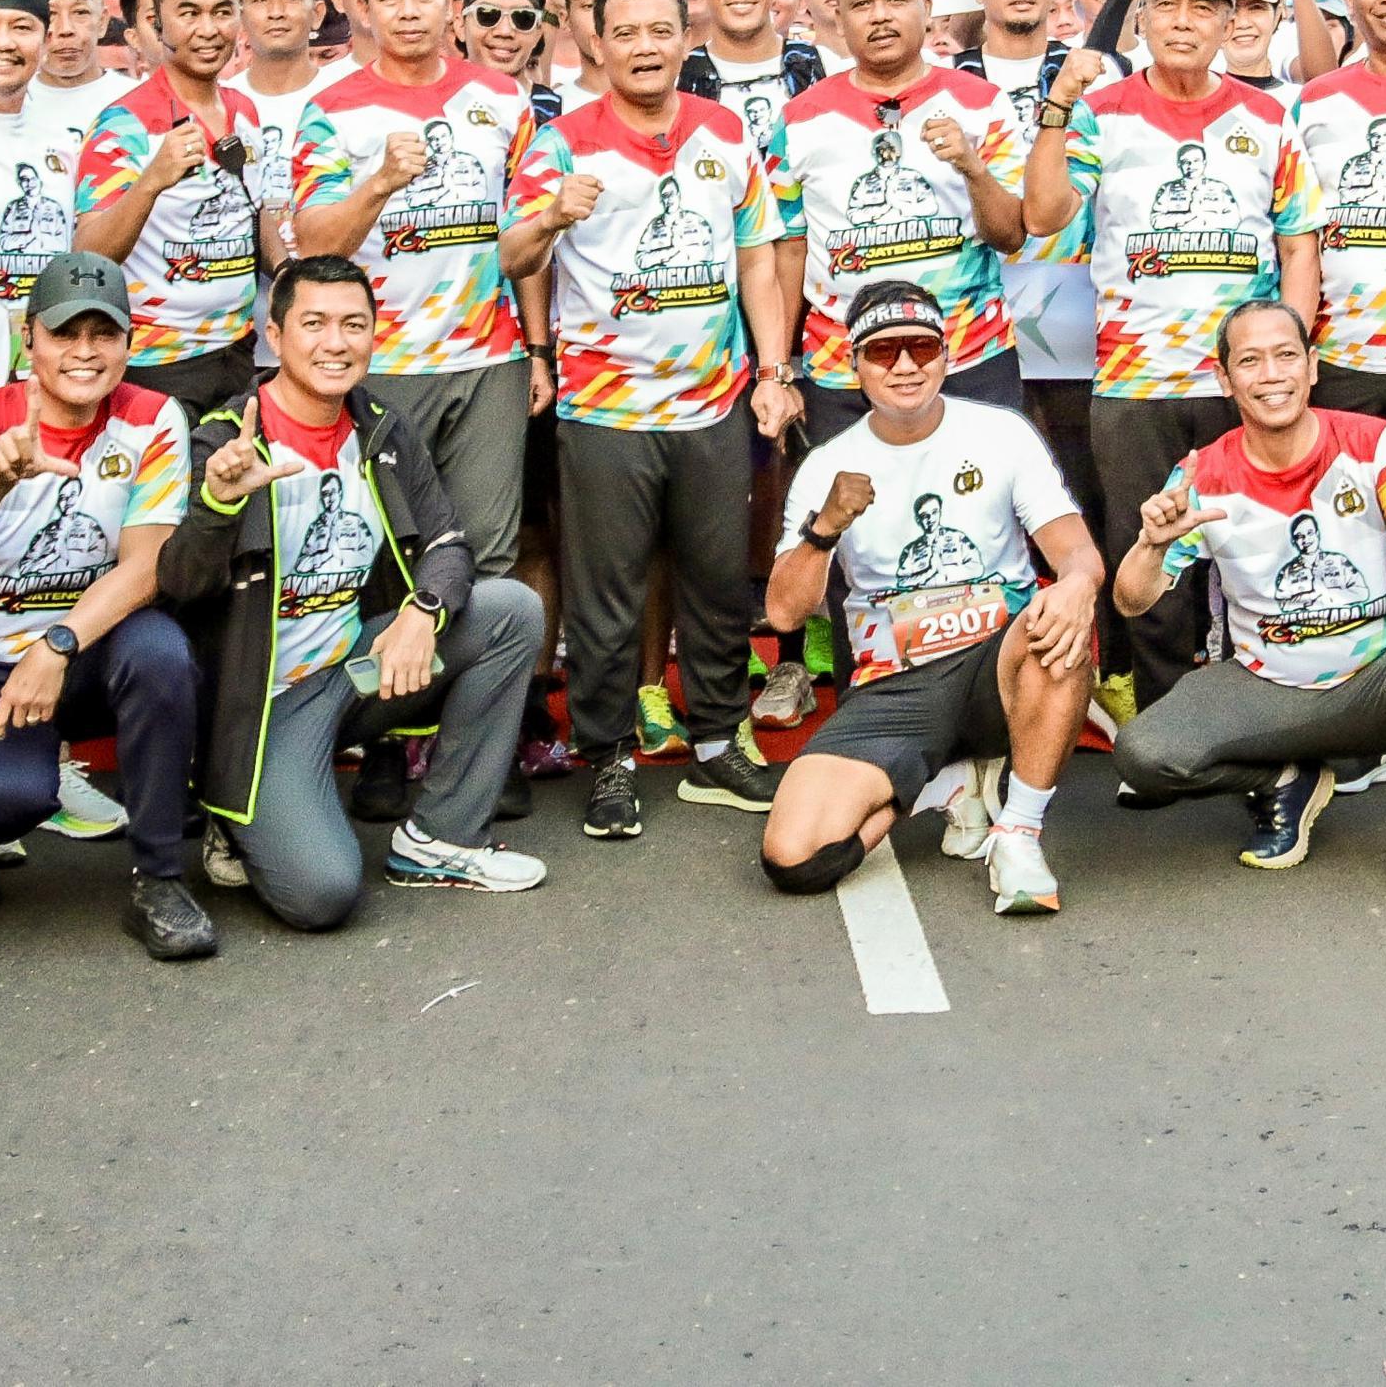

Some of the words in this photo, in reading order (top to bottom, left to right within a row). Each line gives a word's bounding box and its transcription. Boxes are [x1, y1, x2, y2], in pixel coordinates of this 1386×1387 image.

[427, 225, 477, 240] JATENG
[930, 218, 962, 237] RUN
[867, 242, 925, 259] JATENG
[928, 235, 963, 251] 2024
[1126, 232, 1229, 254] BHAYANGKARA
[1233, 233, 1256, 253] RUN
[1168, 254, 1226, 265] JATENG
[1229, 254, 1259, 265] 2024
[658, 286, 711, 302] JATENG
[919, 603, 1000, 645] 2907
